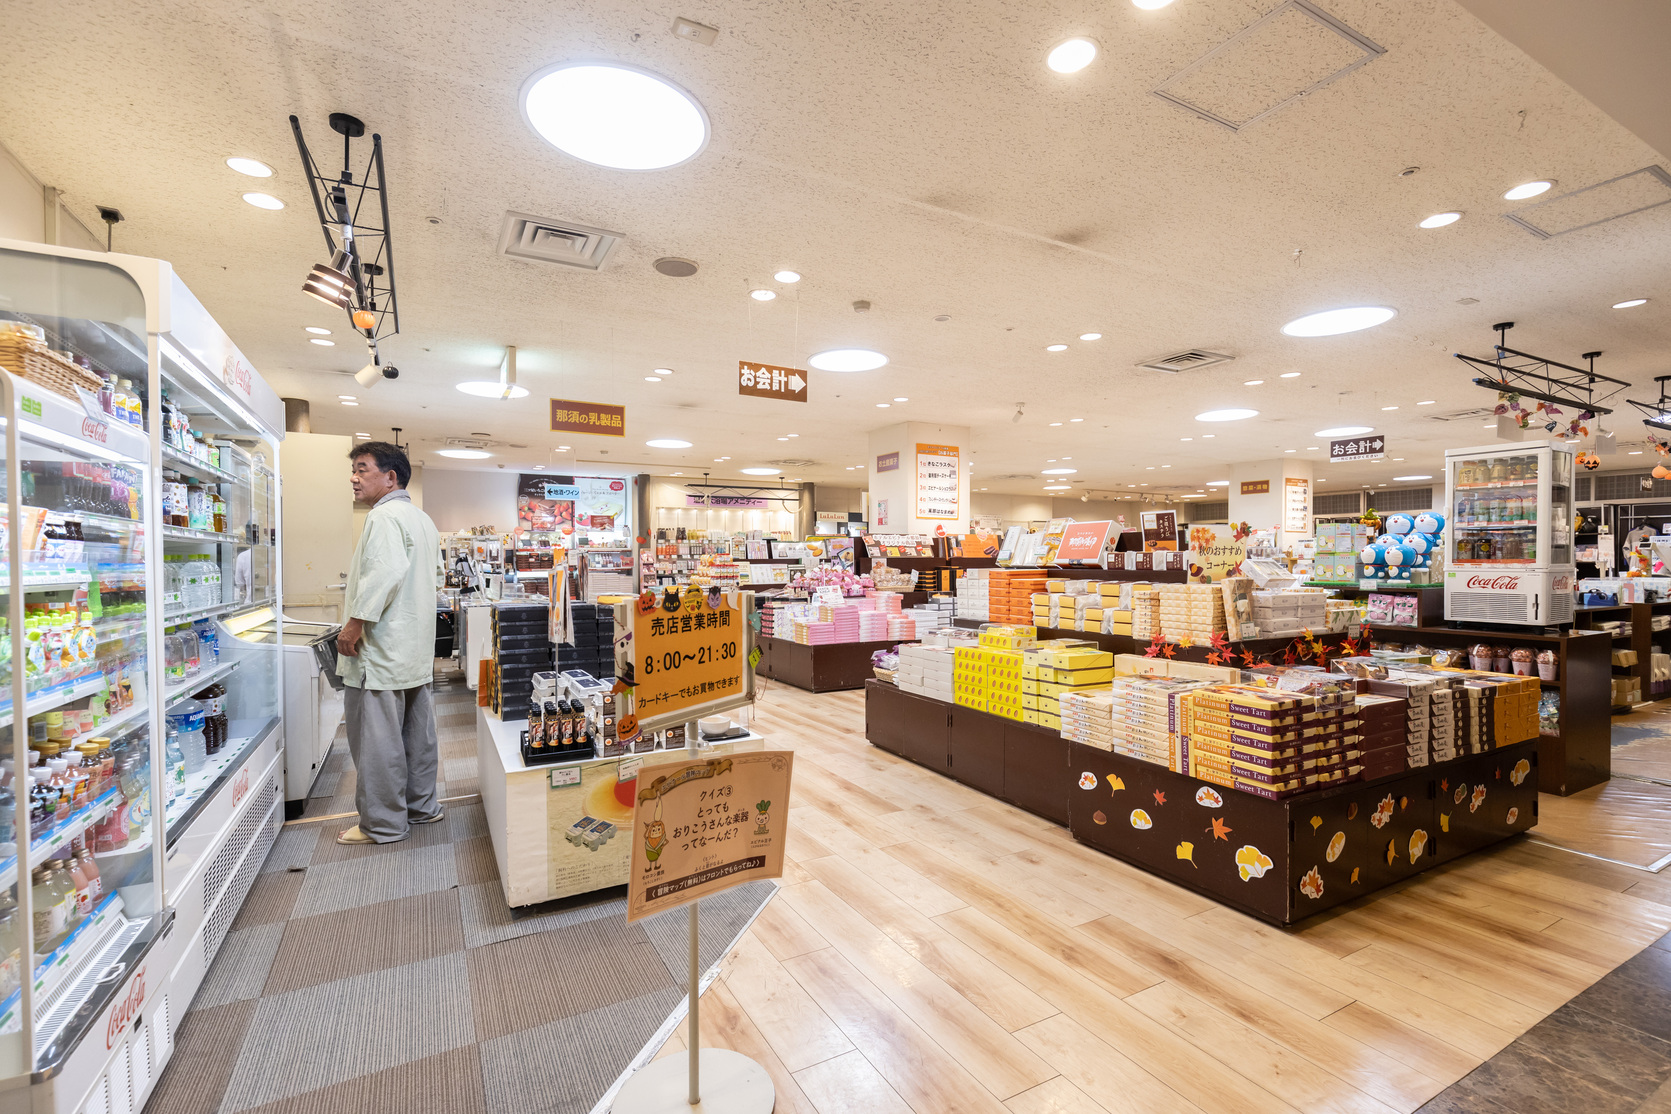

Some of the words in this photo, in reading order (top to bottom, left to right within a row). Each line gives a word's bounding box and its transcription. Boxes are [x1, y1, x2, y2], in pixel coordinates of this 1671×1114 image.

[741, 365, 788, 393] お会計
[556, 409, 622, 427] 那須の乳製品
[1332, 439, 1372, 456] お会計
[553, 488, 580, 496] 地酒・ワイン
[1199, 545, 1242, 557] 秋のおすすめ
[1206, 560, 1235, 570] コーナー
[1466, 574, 1522, 590] Coca-Cola
[651, 610, 731, 637] 売店営業時間
[639, 675, 740, 709] カードキーでもお買物できます
[1195, 697, 1227, 709] Platinum
[1230, 704, 1249, 714] Sweet
[1251, 707, 1266, 717] Tart
[1196, 711, 1228, 724] Platinum
[1231, 719, 1250, 729] Sweet
[1252, 722, 1267, 733] Tart
[1197, 726, 1229, 740] Platinum
[1232, 734, 1251, 745] Sweet
[1252, 739, 1268, 749] Tart
[1196, 742, 1228, 755] Platinum
[1231, 750, 1250, 761] Sweet
[1252, 755, 1268, 765] Tart
[1197, 756, 1229, 771] Platinum
[1232, 766, 1251, 777] Sweet
[1252, 770, 1268, 782] Tart
[1200, 771, 1232, 786] Platinum
[1235, 781, 1254, 793] Sweet
[1256, 786, 1272, 797] Tart
[697, 802, 729, 818] とっても
[673, 810, 749, 839] おりこうさんな楽器
